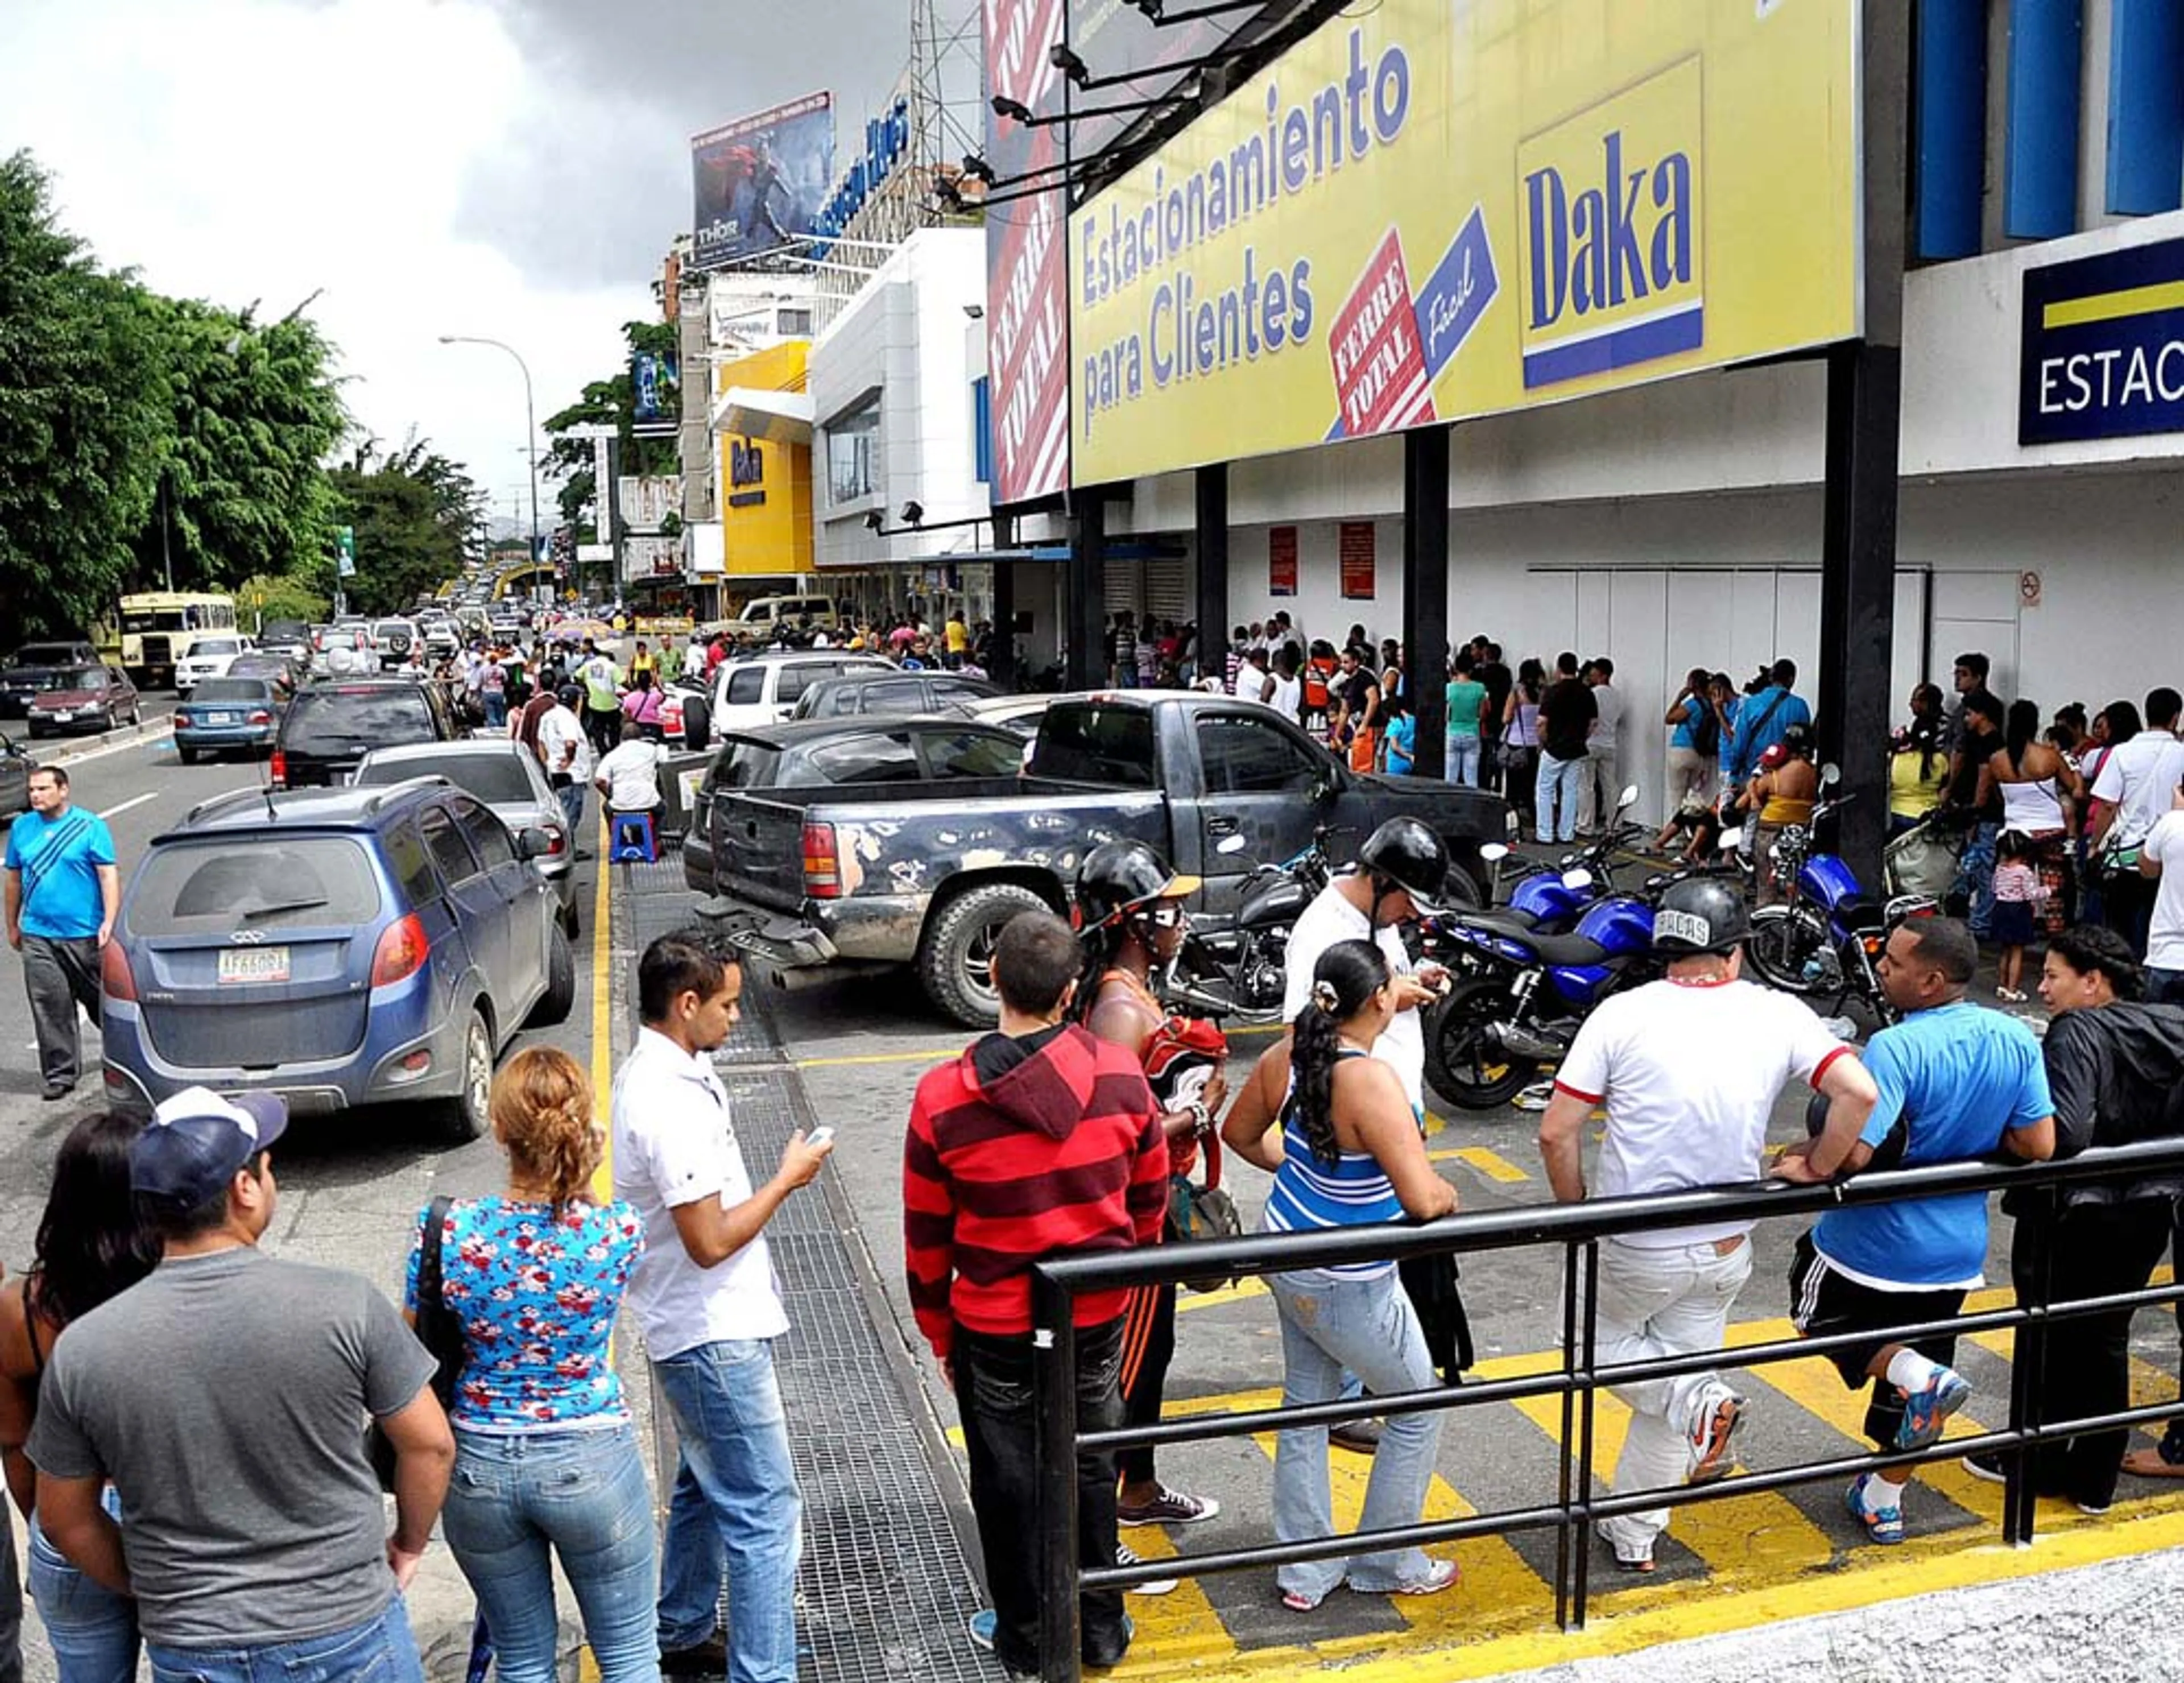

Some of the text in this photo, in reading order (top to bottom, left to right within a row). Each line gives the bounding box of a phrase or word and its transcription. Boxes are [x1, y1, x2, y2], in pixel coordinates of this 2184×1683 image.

[698, 219, 738, 244] THOR
[1082, 28, 1408, 305] Estacionamiento
[1524, 130, 1691, 331] Daka
[1001, 281, 1062, 473] TOTAL
[1085, 246, 1312, 439] para Clientes
[1336, 260, 1404, 386] FERRE
[1346, 323, 1412, 432] TOTAL
[2040, 340, 2184, 413] ESTAC
